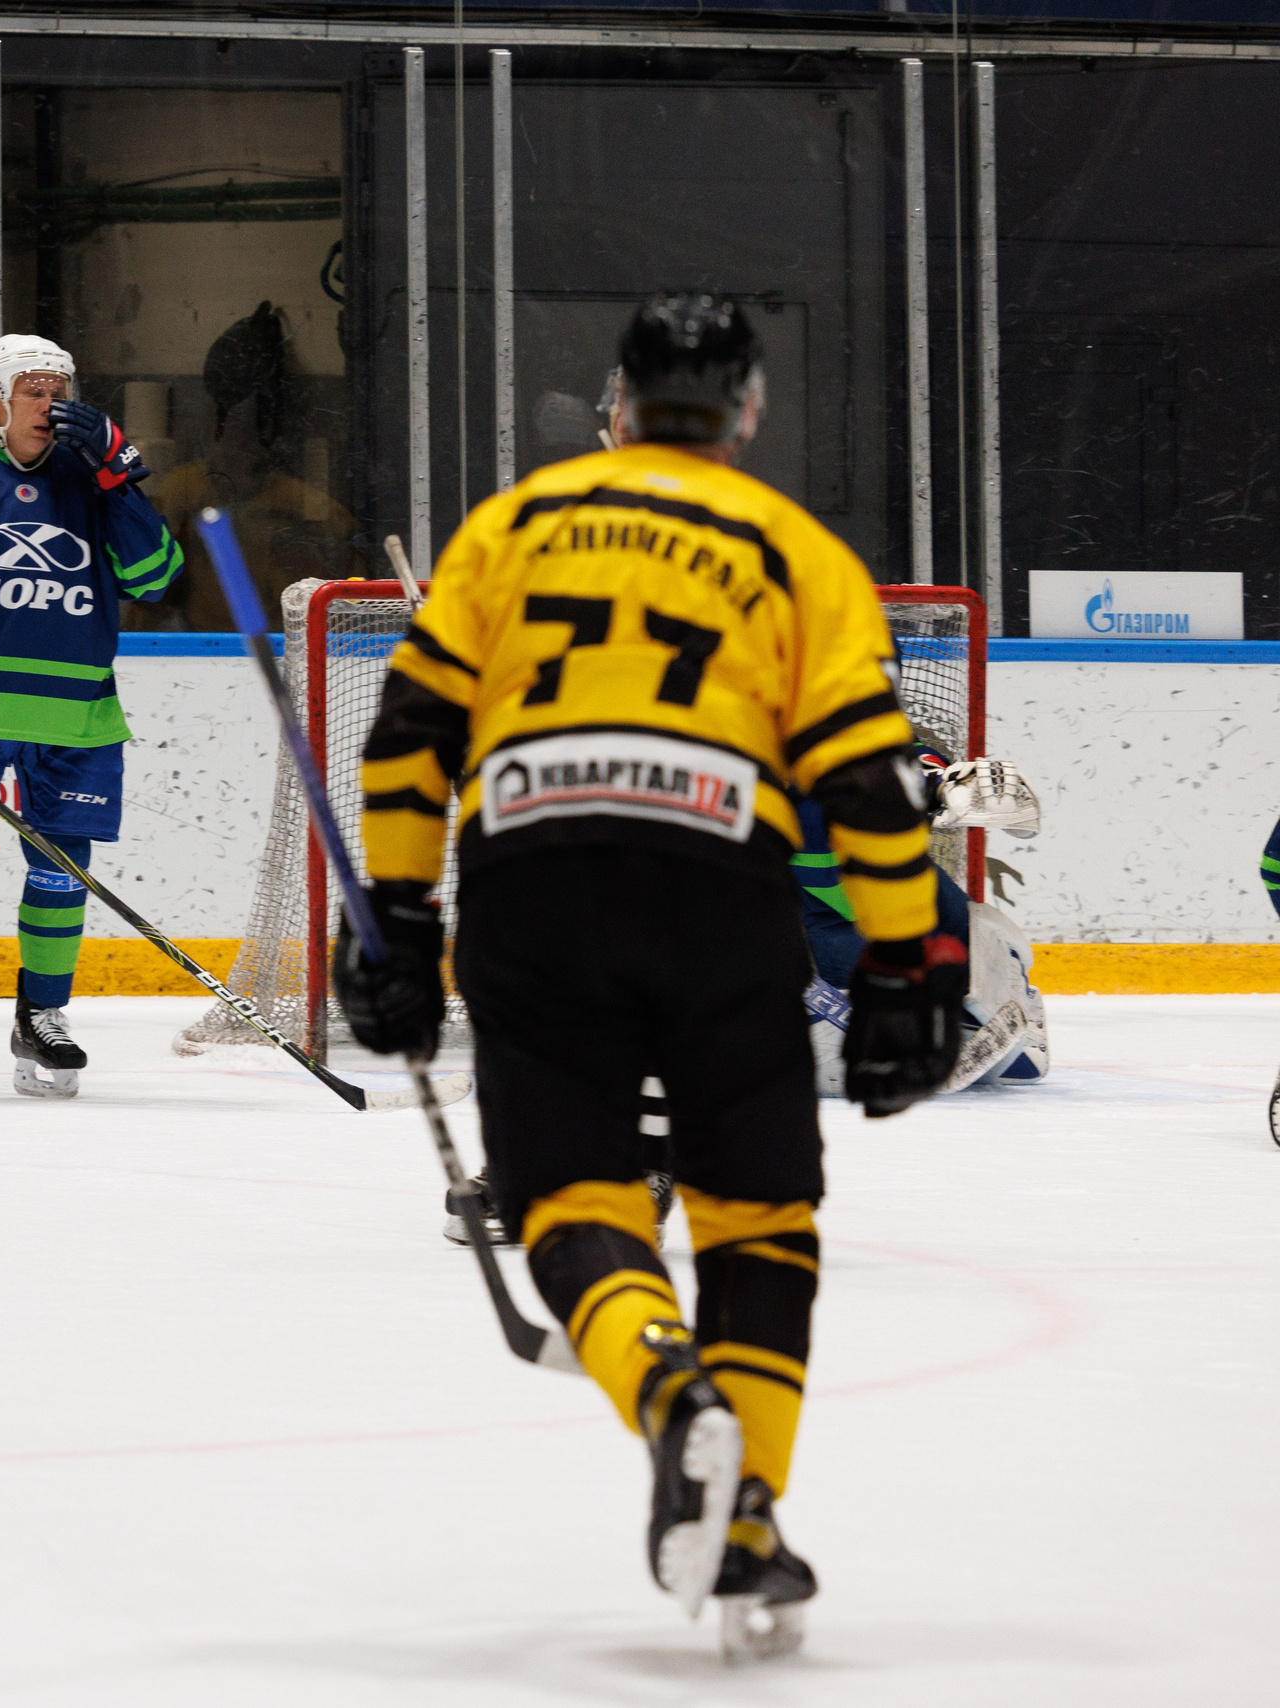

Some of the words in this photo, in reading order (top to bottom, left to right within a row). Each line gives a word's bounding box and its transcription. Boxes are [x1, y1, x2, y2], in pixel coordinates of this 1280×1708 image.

[1116, 612, 1191, 635] ГАЗПРОМ
[521, 593, 723, 708] 77
[59, 791, 108, 805] CCM
